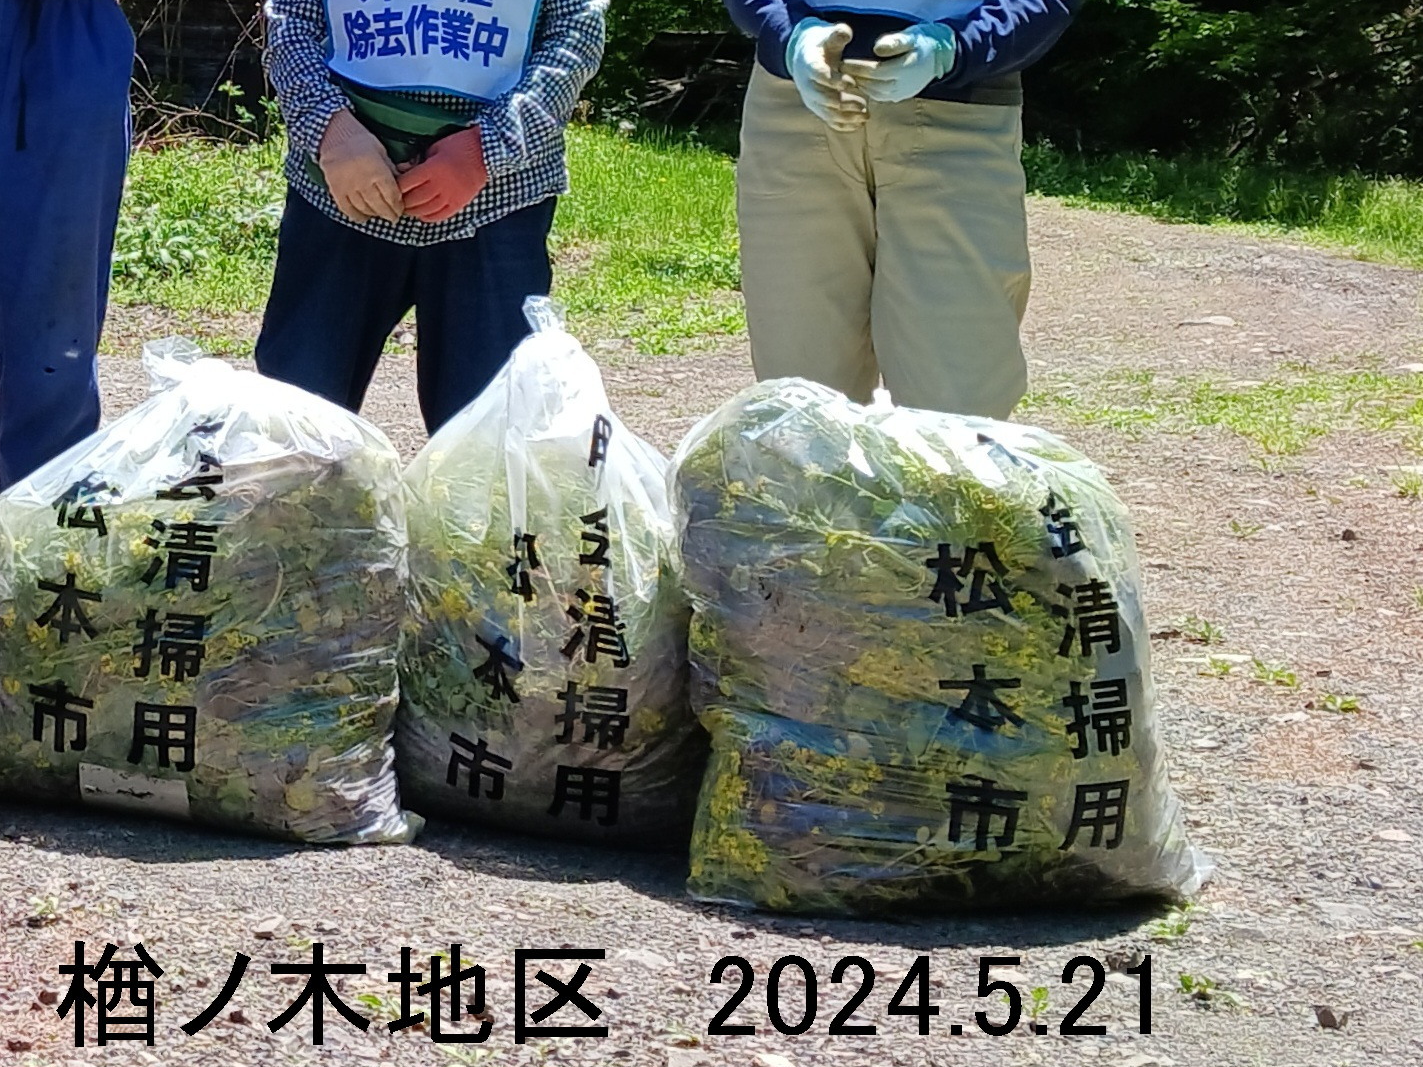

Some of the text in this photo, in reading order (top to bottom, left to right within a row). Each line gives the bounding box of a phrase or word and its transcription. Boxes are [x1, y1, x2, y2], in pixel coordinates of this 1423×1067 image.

[343, 4, 510, 67] 除去作業中
[925, 541, 1029, 853] 松本市
